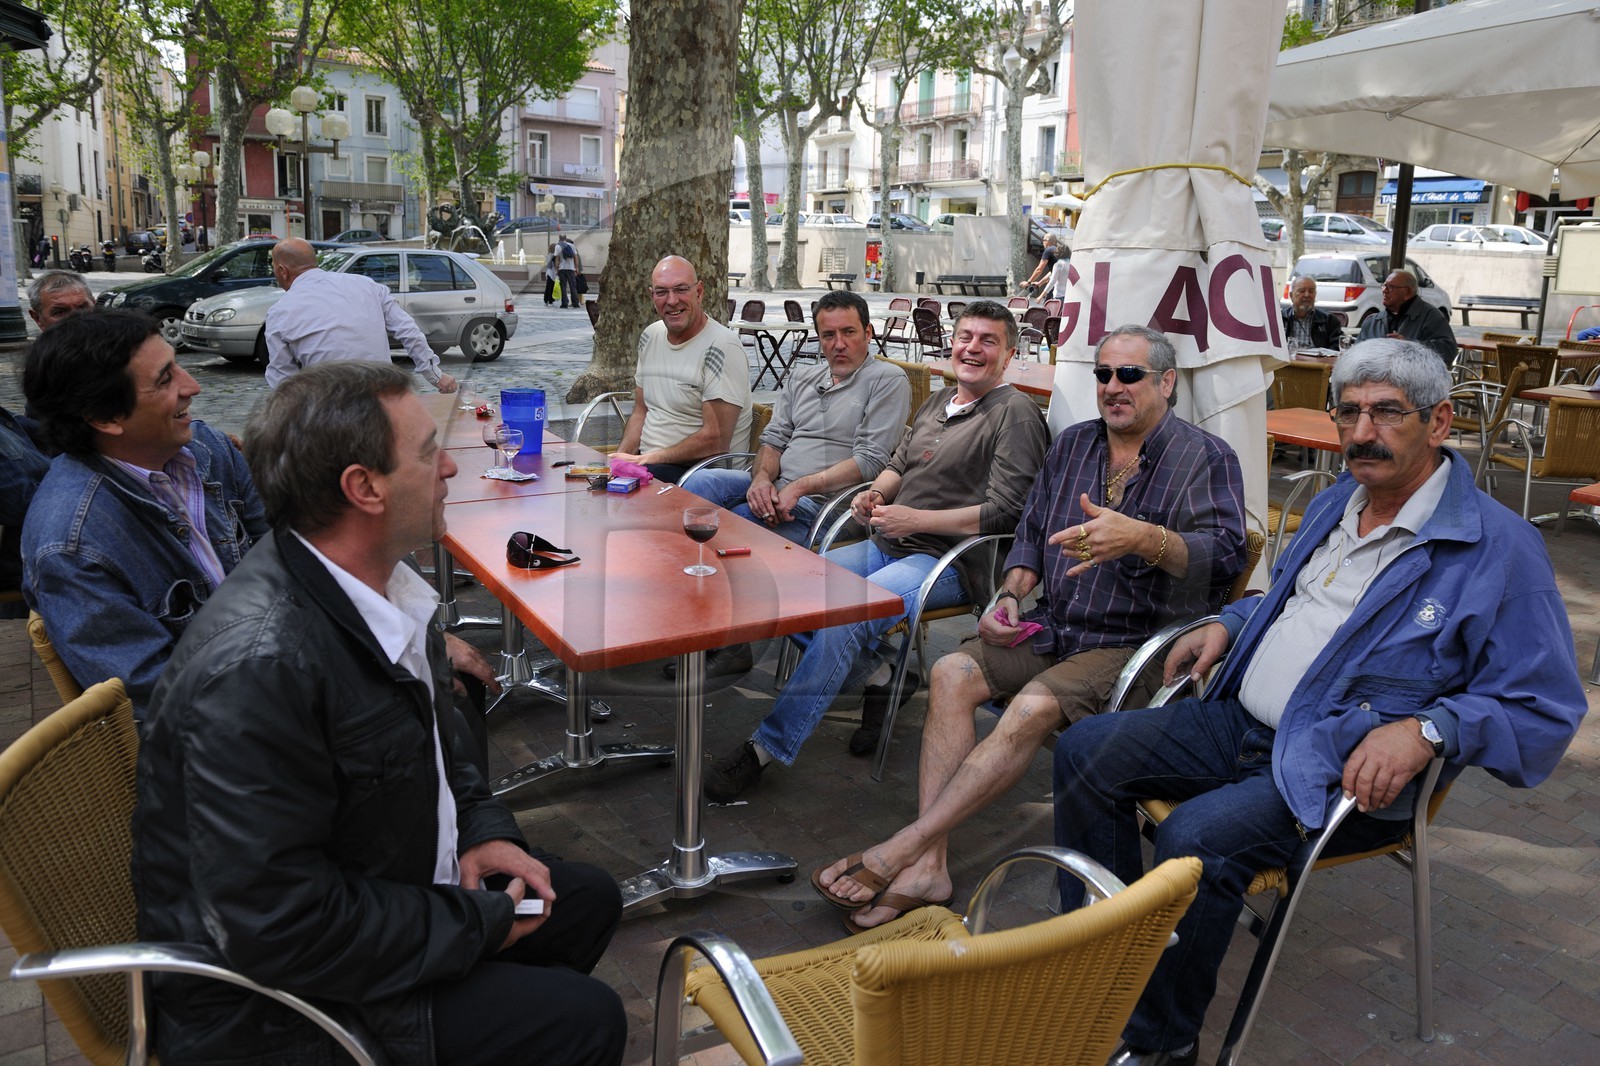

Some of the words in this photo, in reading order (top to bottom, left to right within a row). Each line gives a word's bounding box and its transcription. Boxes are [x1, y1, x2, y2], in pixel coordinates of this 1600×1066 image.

[1411, 193, 1420, 202] de
[1449, 192, 1460, 201] de
[1463, 191, 1481, 200] Ville
